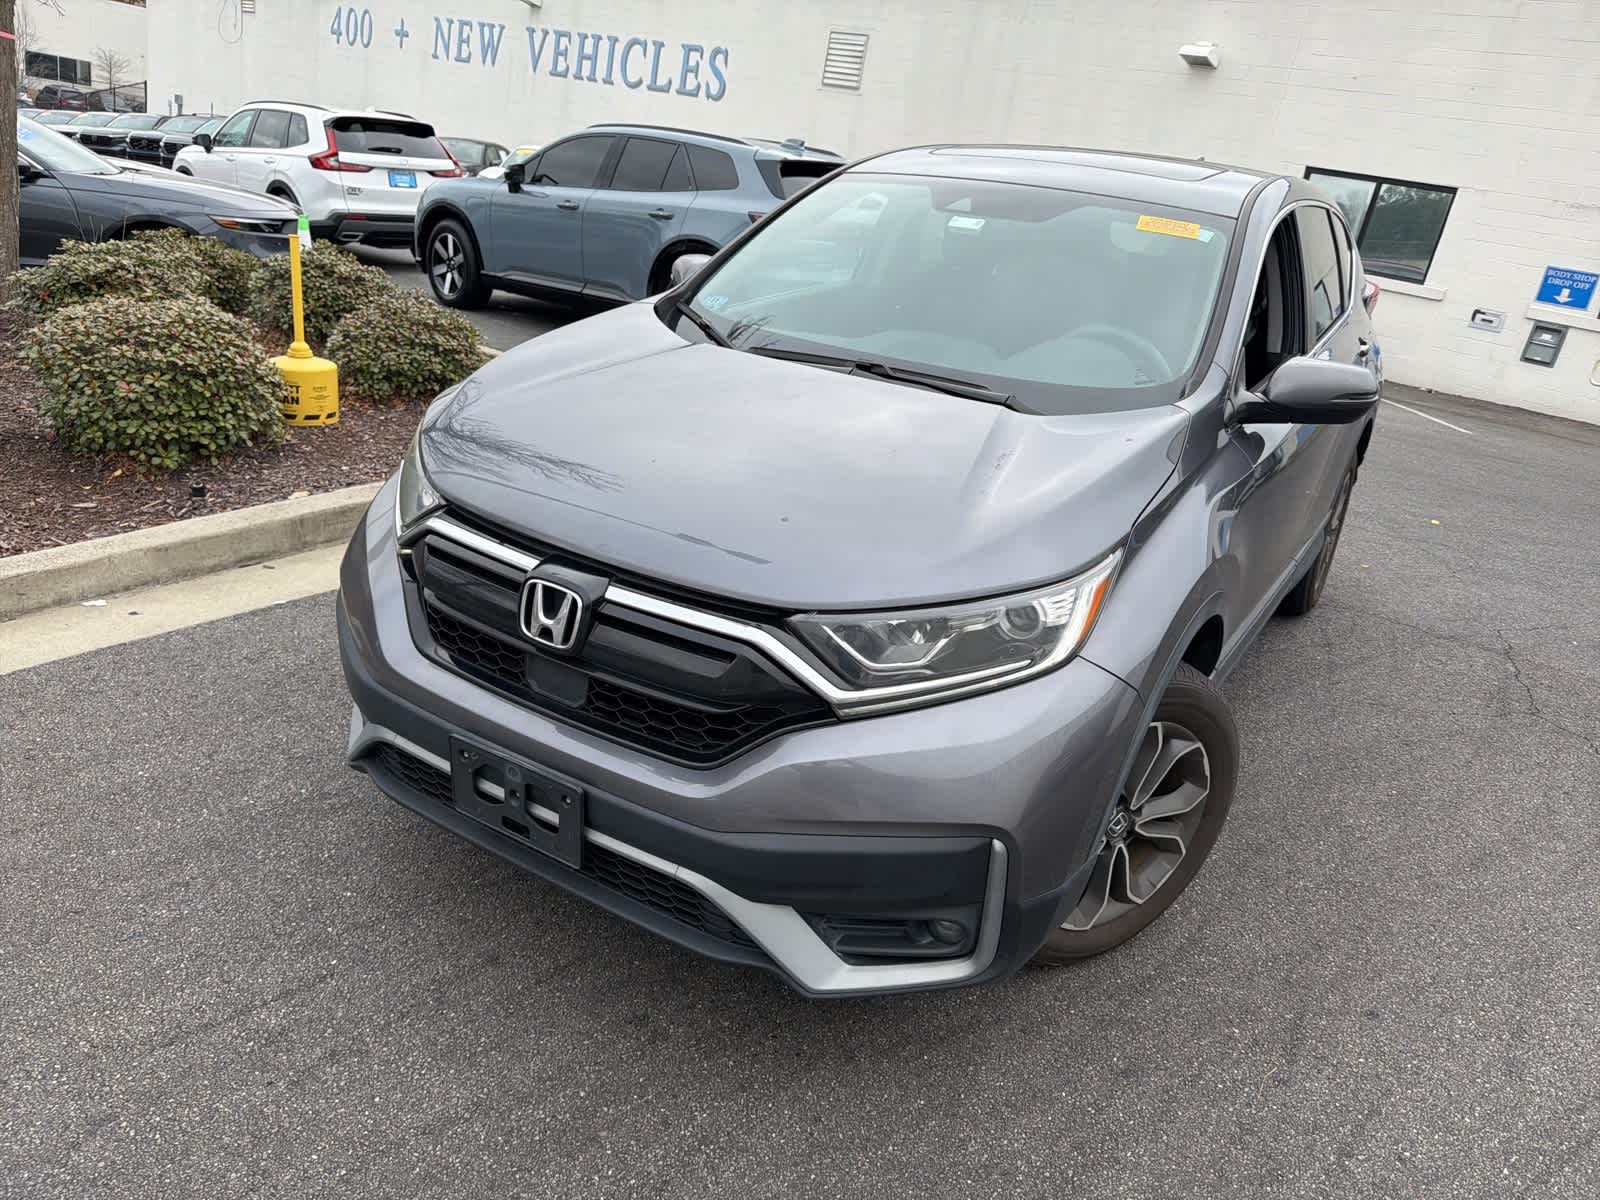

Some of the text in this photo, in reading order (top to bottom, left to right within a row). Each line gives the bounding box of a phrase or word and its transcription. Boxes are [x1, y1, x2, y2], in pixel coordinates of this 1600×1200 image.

[330, 7, 729, 101] 400 + NEW VEHICLES
[1547, 269, 1597, 283] BODY SHOP
[1547, 277, 1592, 290] DROP OFF
